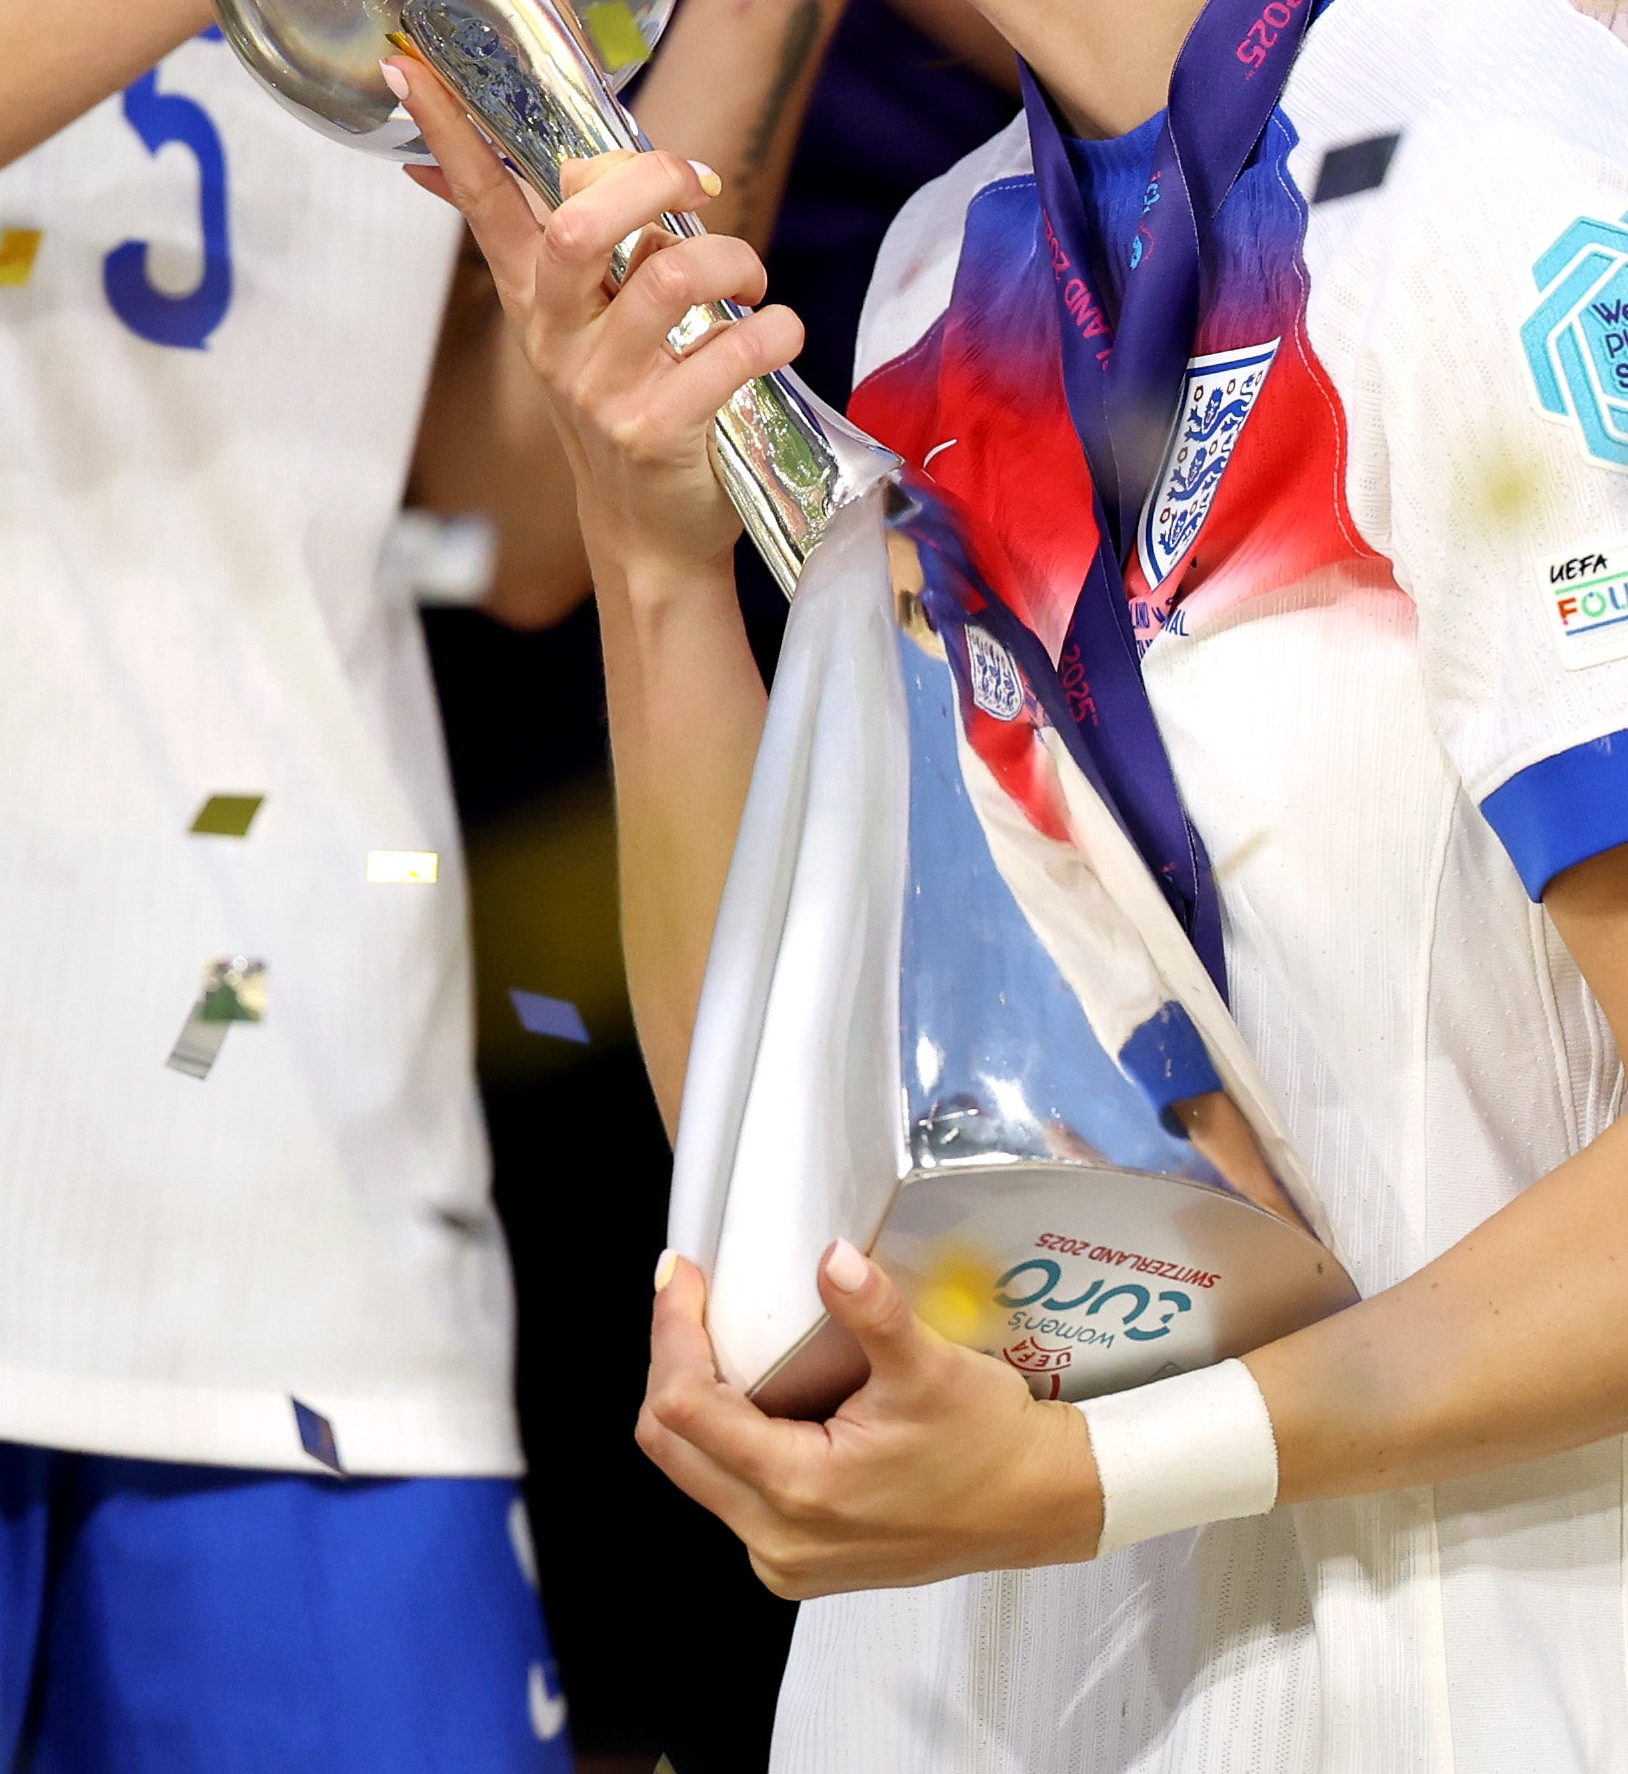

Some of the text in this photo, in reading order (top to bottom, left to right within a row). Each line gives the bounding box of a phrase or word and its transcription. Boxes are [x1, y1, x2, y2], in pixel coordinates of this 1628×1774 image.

[1550, 554, 1608, 584] UEFA
[1036, 1232, 1221, 1289] SWITZERLAND 2025
[1008, 1311, 1114, 1349] women's
[1011, 1338, 1071, 1367] UEFA
